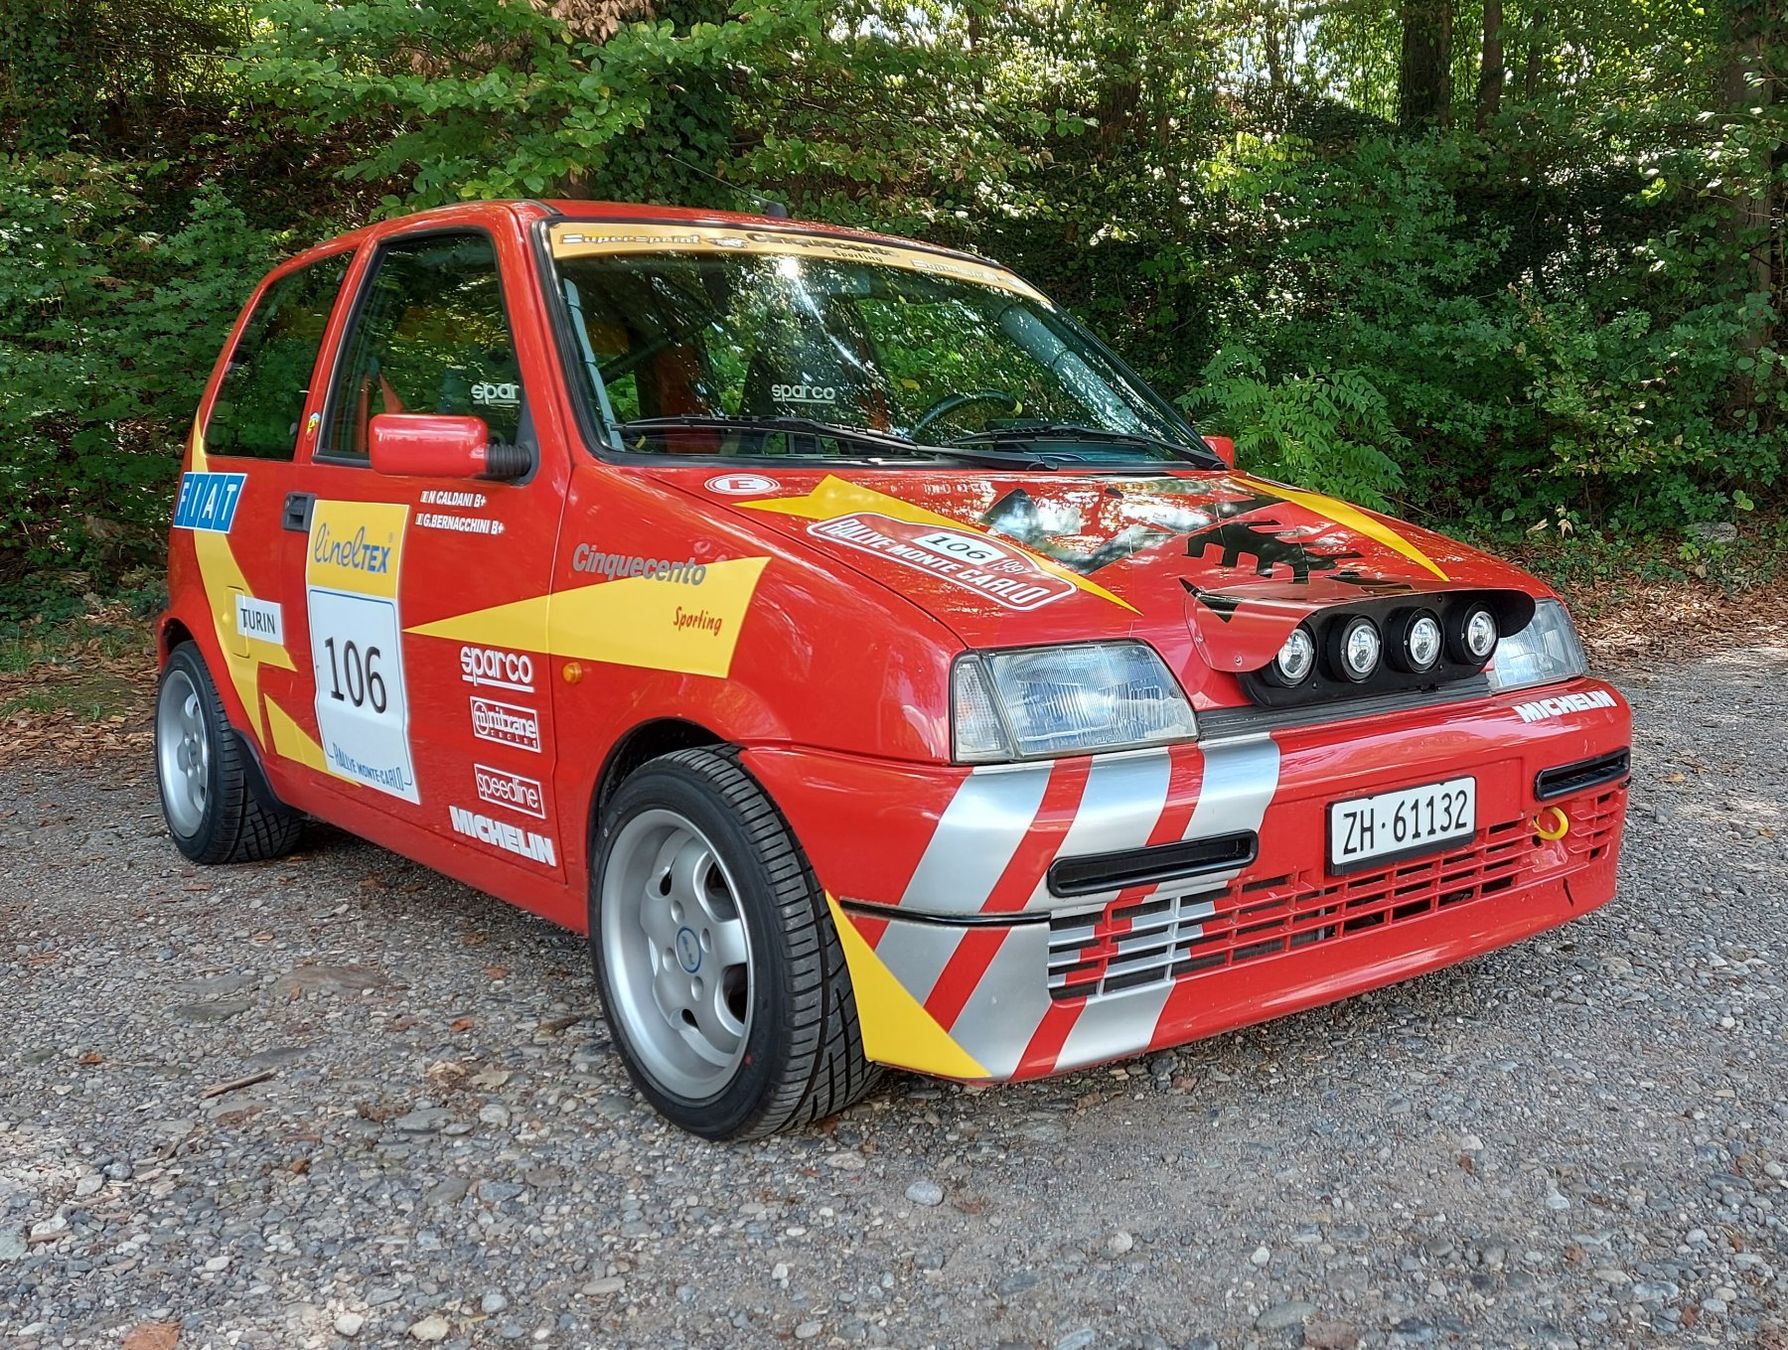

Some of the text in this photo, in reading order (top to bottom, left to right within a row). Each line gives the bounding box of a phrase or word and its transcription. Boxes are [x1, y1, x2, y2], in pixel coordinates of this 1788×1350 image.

[832, 249, 884, 262] Sporting
[771, 384, 836, 402] sparco
[436, 491, 474, 507] CALDANI
[728, 479, 758, 490] E
[177, 482, 238, 521] FIAT
[817, 518, 1051, 604] RALLYE MONTE CARLO
[925, 535, 992, 559] 106
[573, 543, 706, 586] Cinquecento
[240, 608, 276, 635] TURIN
[673, 606, 723, 637] Sporting
[324, 637, 387, 714] 106
[461, 646, 532, 687] sparco
[1511, 690, 1618, 723] MICHELIN
[478, 774, 538, 808] speedline
[449, 805, 557, 867] MICHELIN
